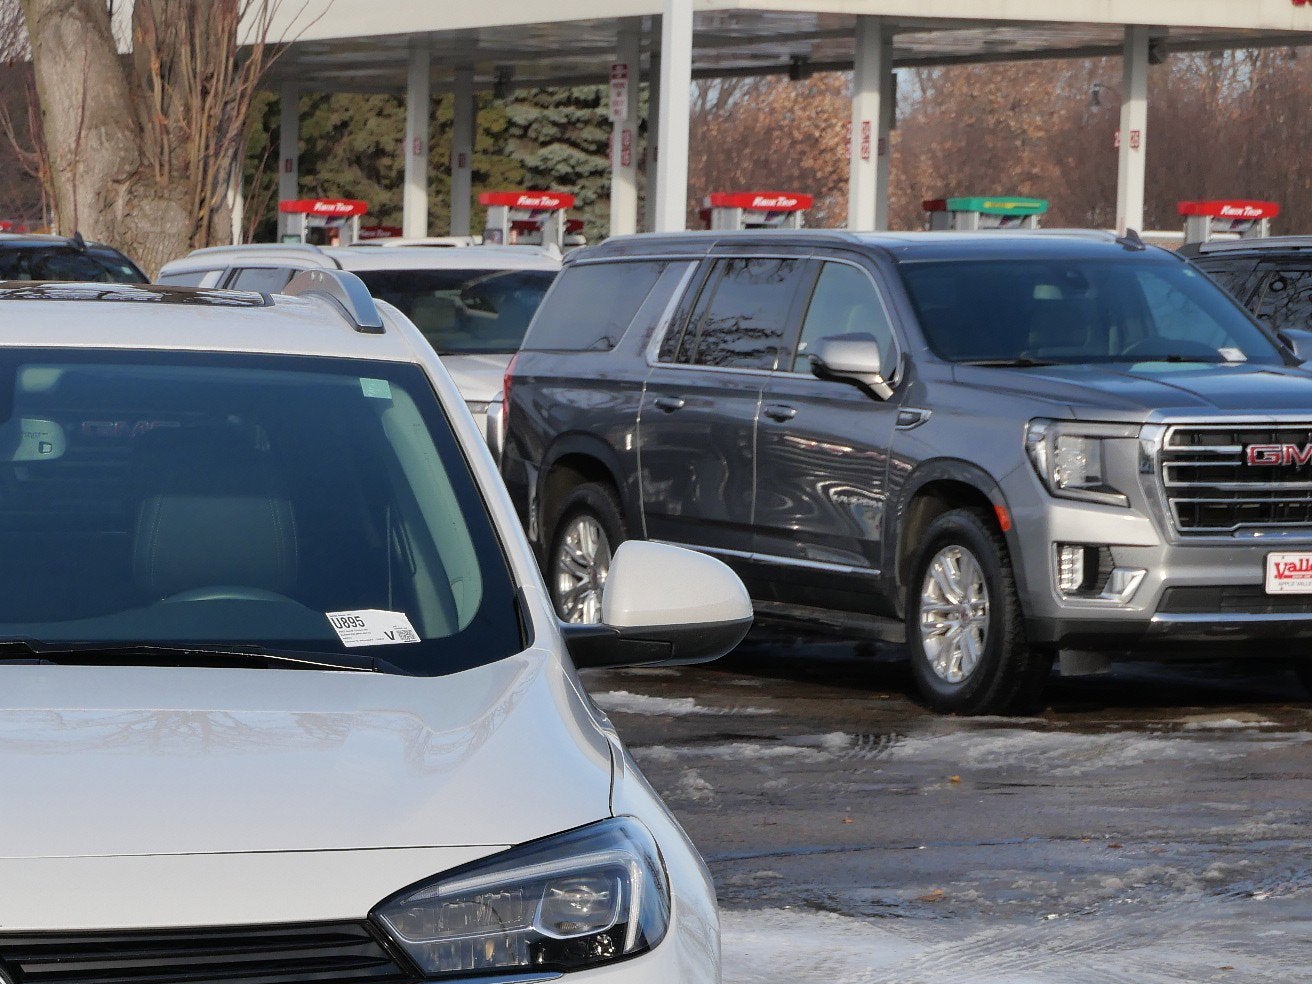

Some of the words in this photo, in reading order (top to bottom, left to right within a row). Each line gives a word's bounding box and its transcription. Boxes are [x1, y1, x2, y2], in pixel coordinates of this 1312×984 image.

[1246, 443, 1312, 466] GM
[1274, 558, 1312, 580] Vall
[331, 616, 365, 629] U895
[384, 631, 395, 641] V
